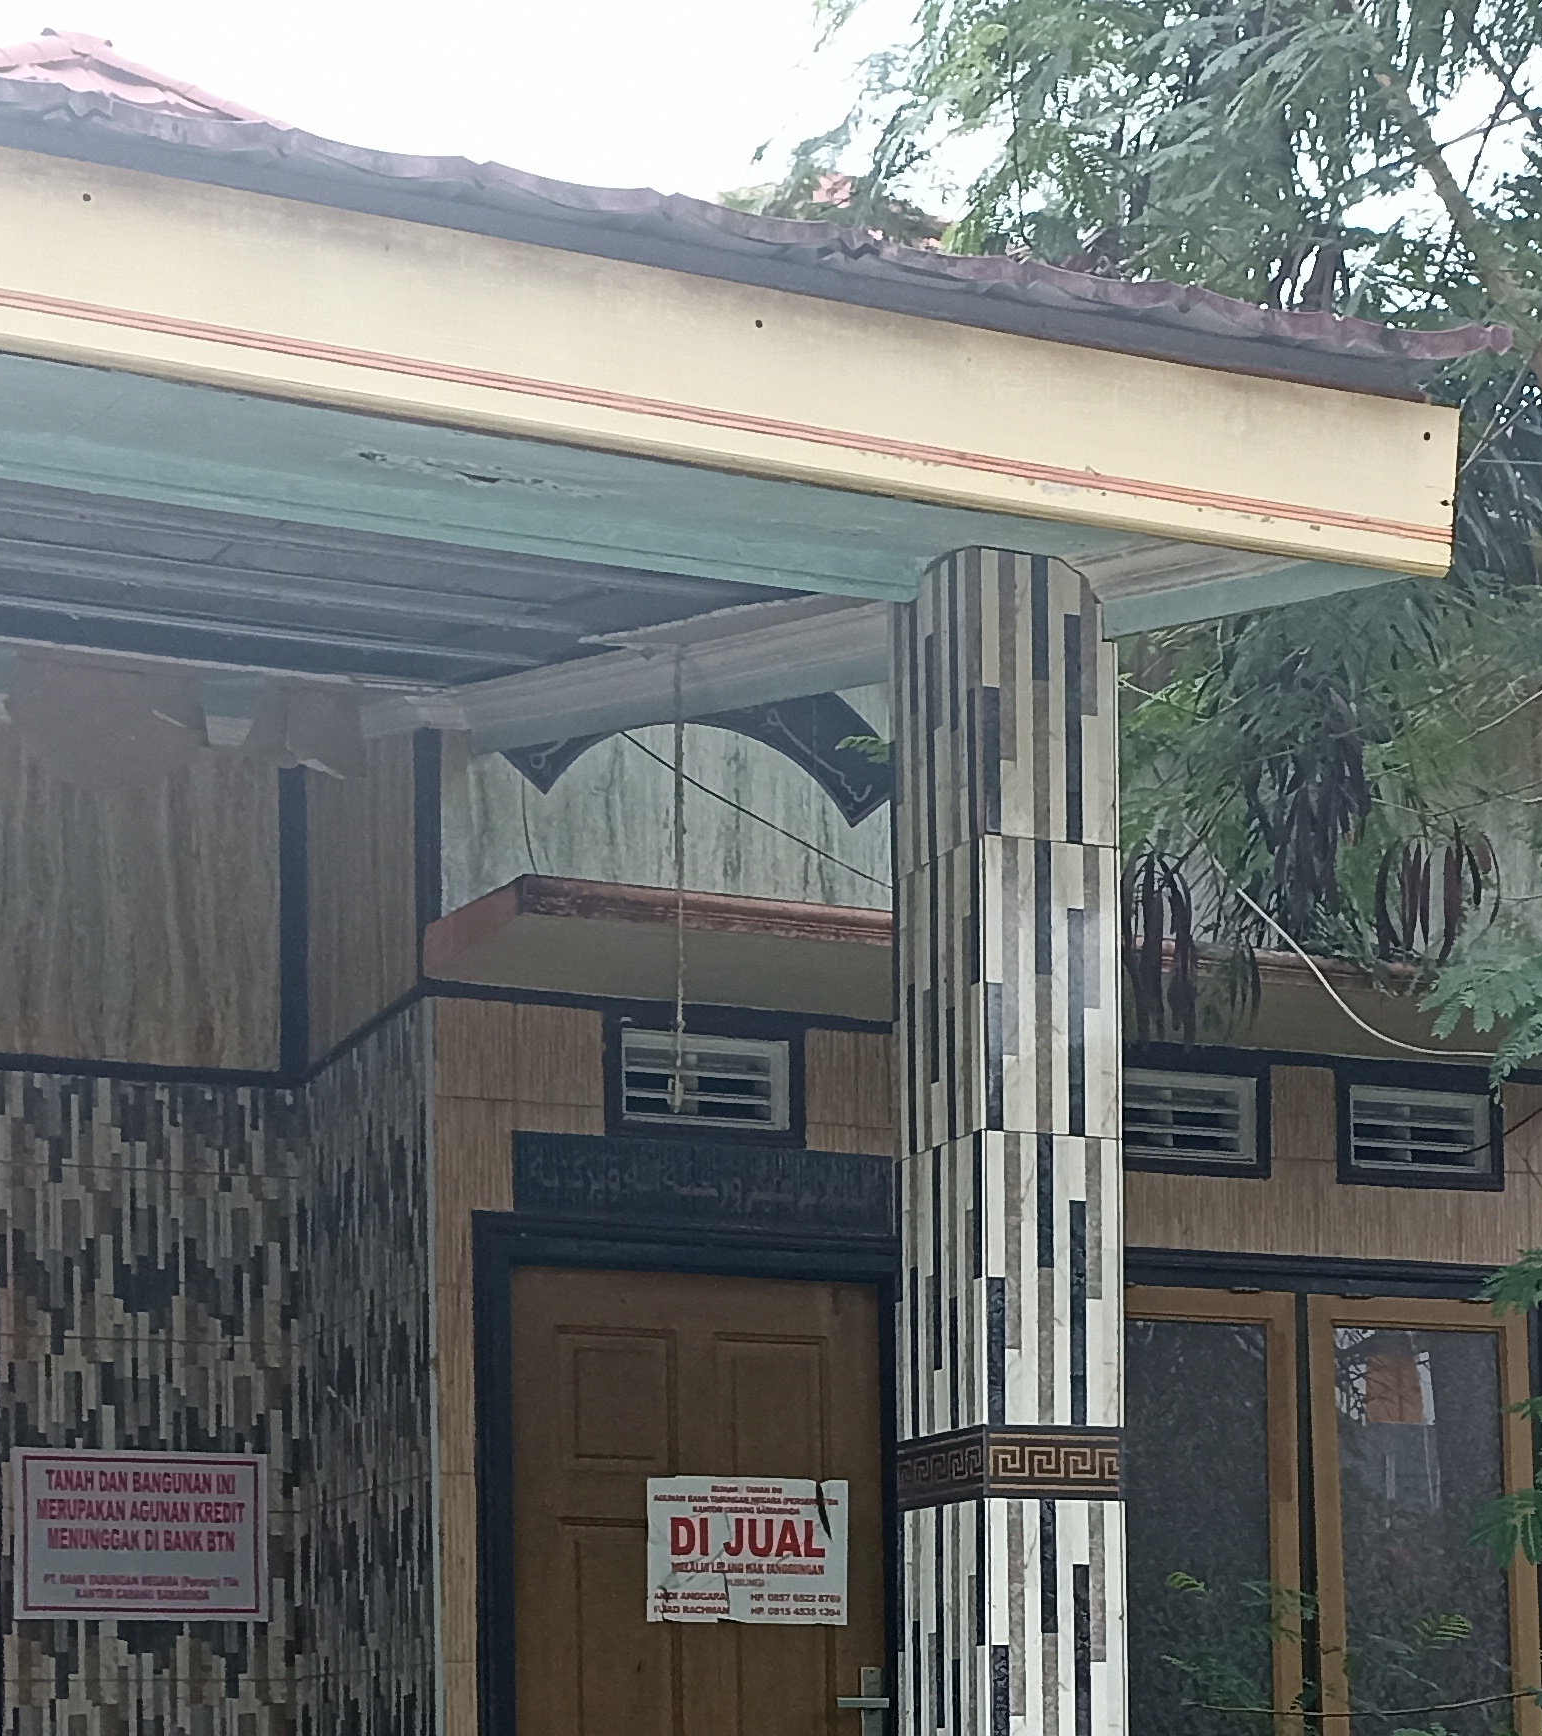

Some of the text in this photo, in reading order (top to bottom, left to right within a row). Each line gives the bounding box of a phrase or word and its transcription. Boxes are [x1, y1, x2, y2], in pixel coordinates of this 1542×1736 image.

[45, 1469, 236, 1495] TANAH DAN BANGUNAN INI
[36, 1498, 245, 1524] MERUPAKAN AGUNAN KREDIT
[47, 1527, 236, 1552] MENUNGGAK DI BANK BTN
[670, 1516, 825, 1557] DI JUAL
[711, 1561, 744, 1573] LELANG
[745, 1563, 765, 1574] HAK
[766, 1563, 825, 1575] TANGGUNGAN
[60, 1574, 86, 1585] BANK
[88, 1574, 139, 1586] TABUNGAN
[141, 1575, 179, 1587] NEGARA
[75, 1588, 210, 1601] KANTOR CABANG SAMARINDA
[682, 1605, 730, 1614] RACHMAN
